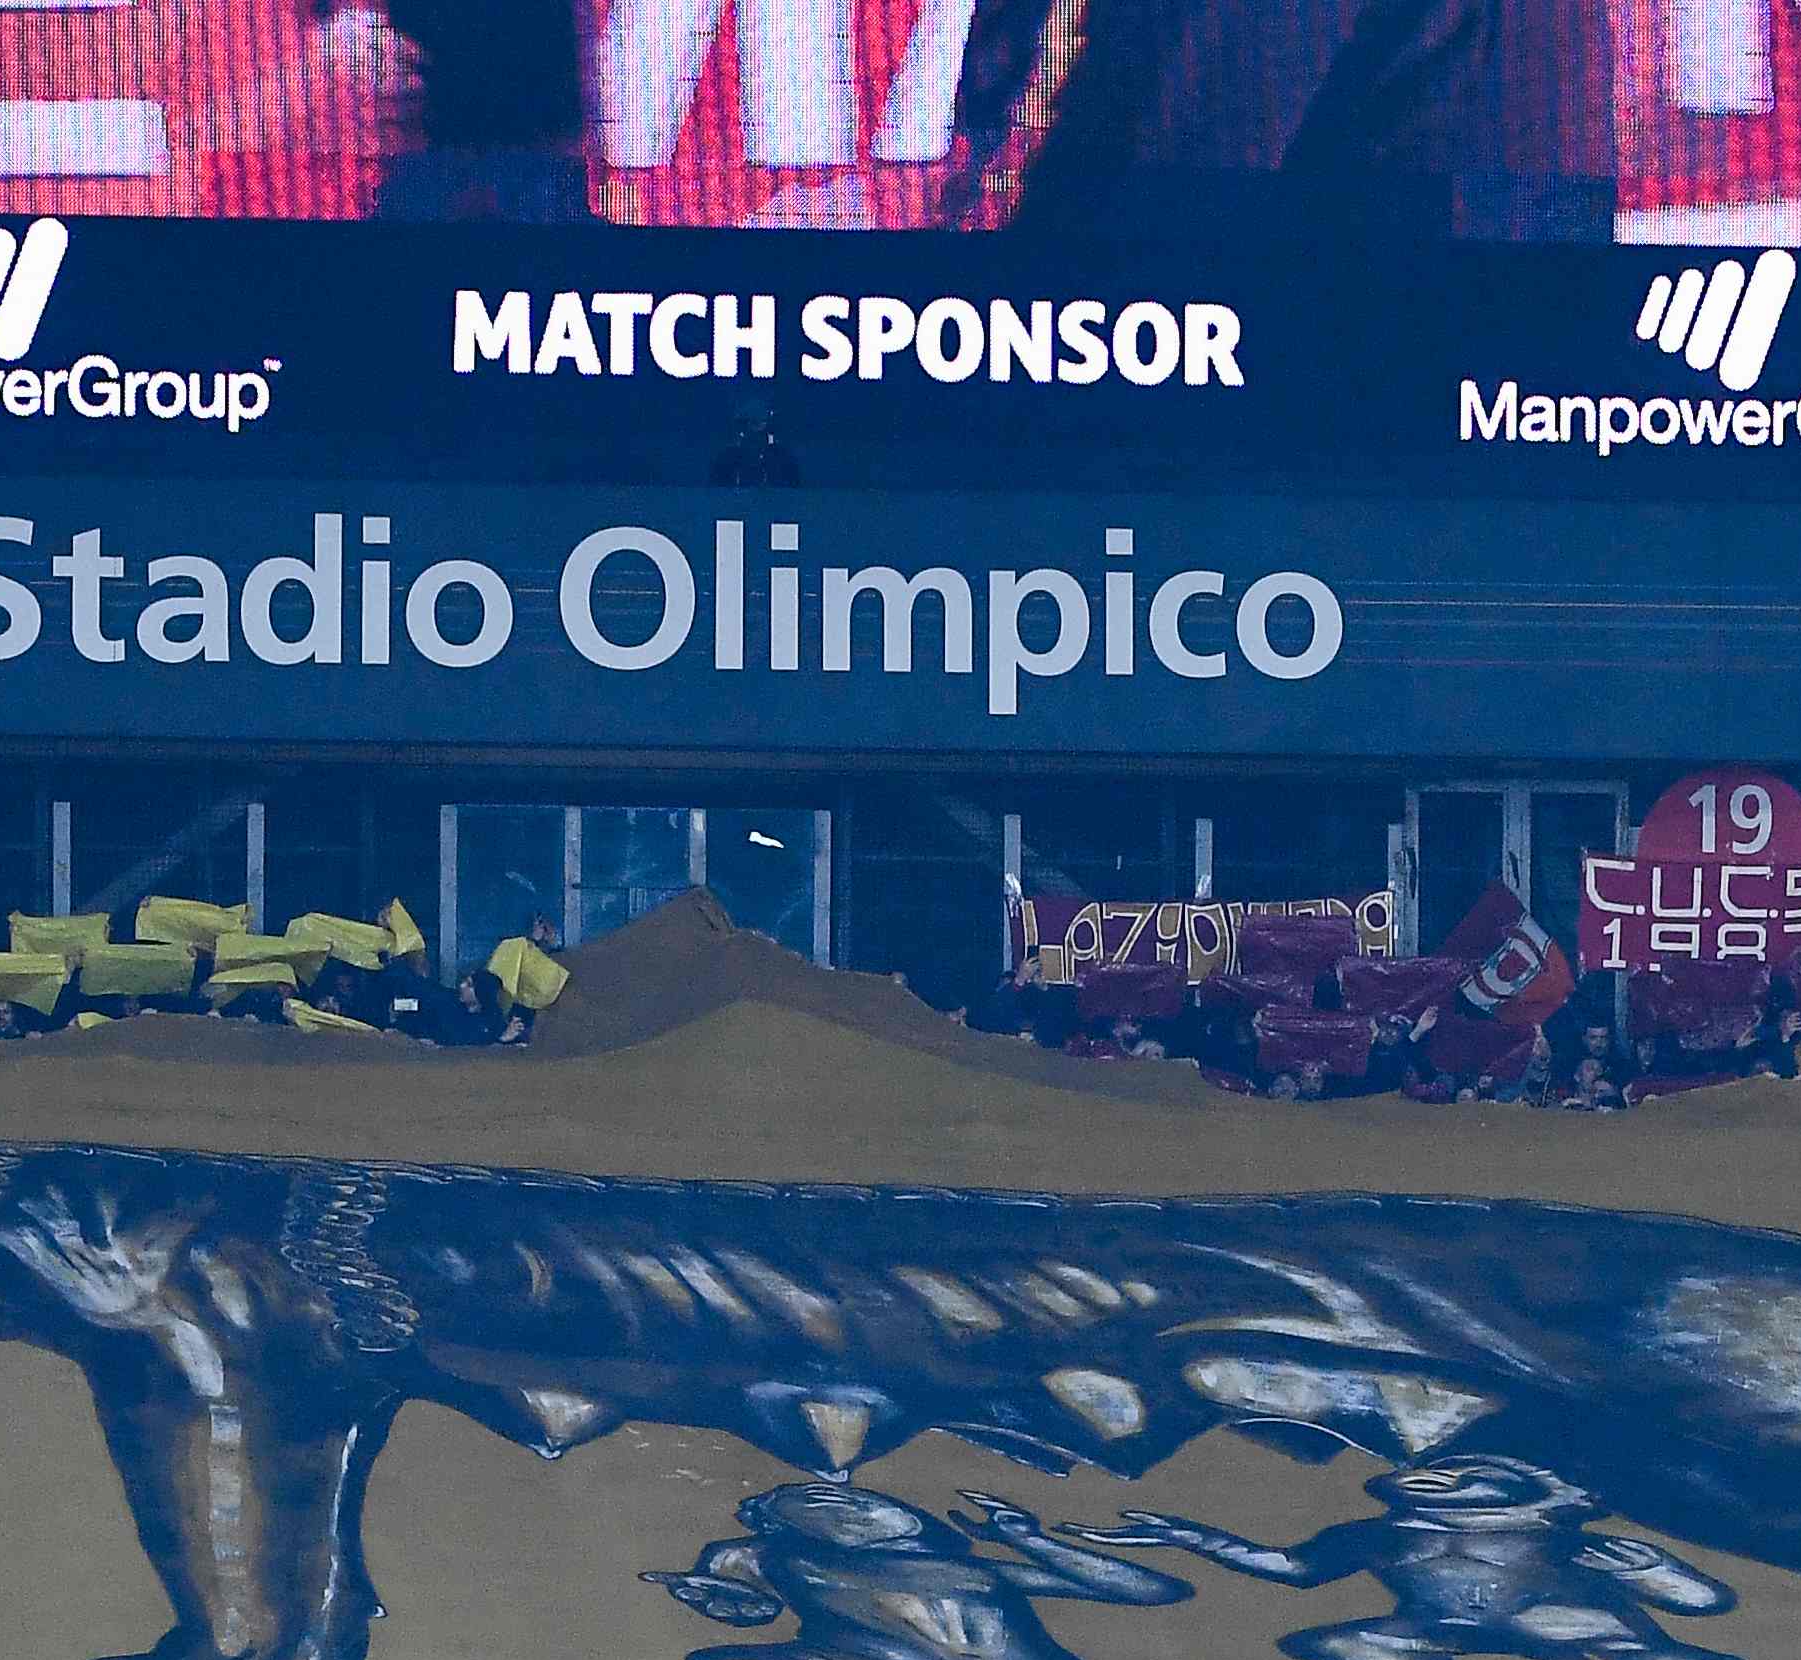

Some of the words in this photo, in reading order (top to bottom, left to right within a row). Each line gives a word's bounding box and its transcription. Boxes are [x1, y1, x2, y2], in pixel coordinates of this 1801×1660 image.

[453, 290, 776, 378] MATCH
[801, 295, 1245, 386] SPONSOR
[559, 520, 1343, 715] Olimpico
[1687, 784, 1773, 855] 19
